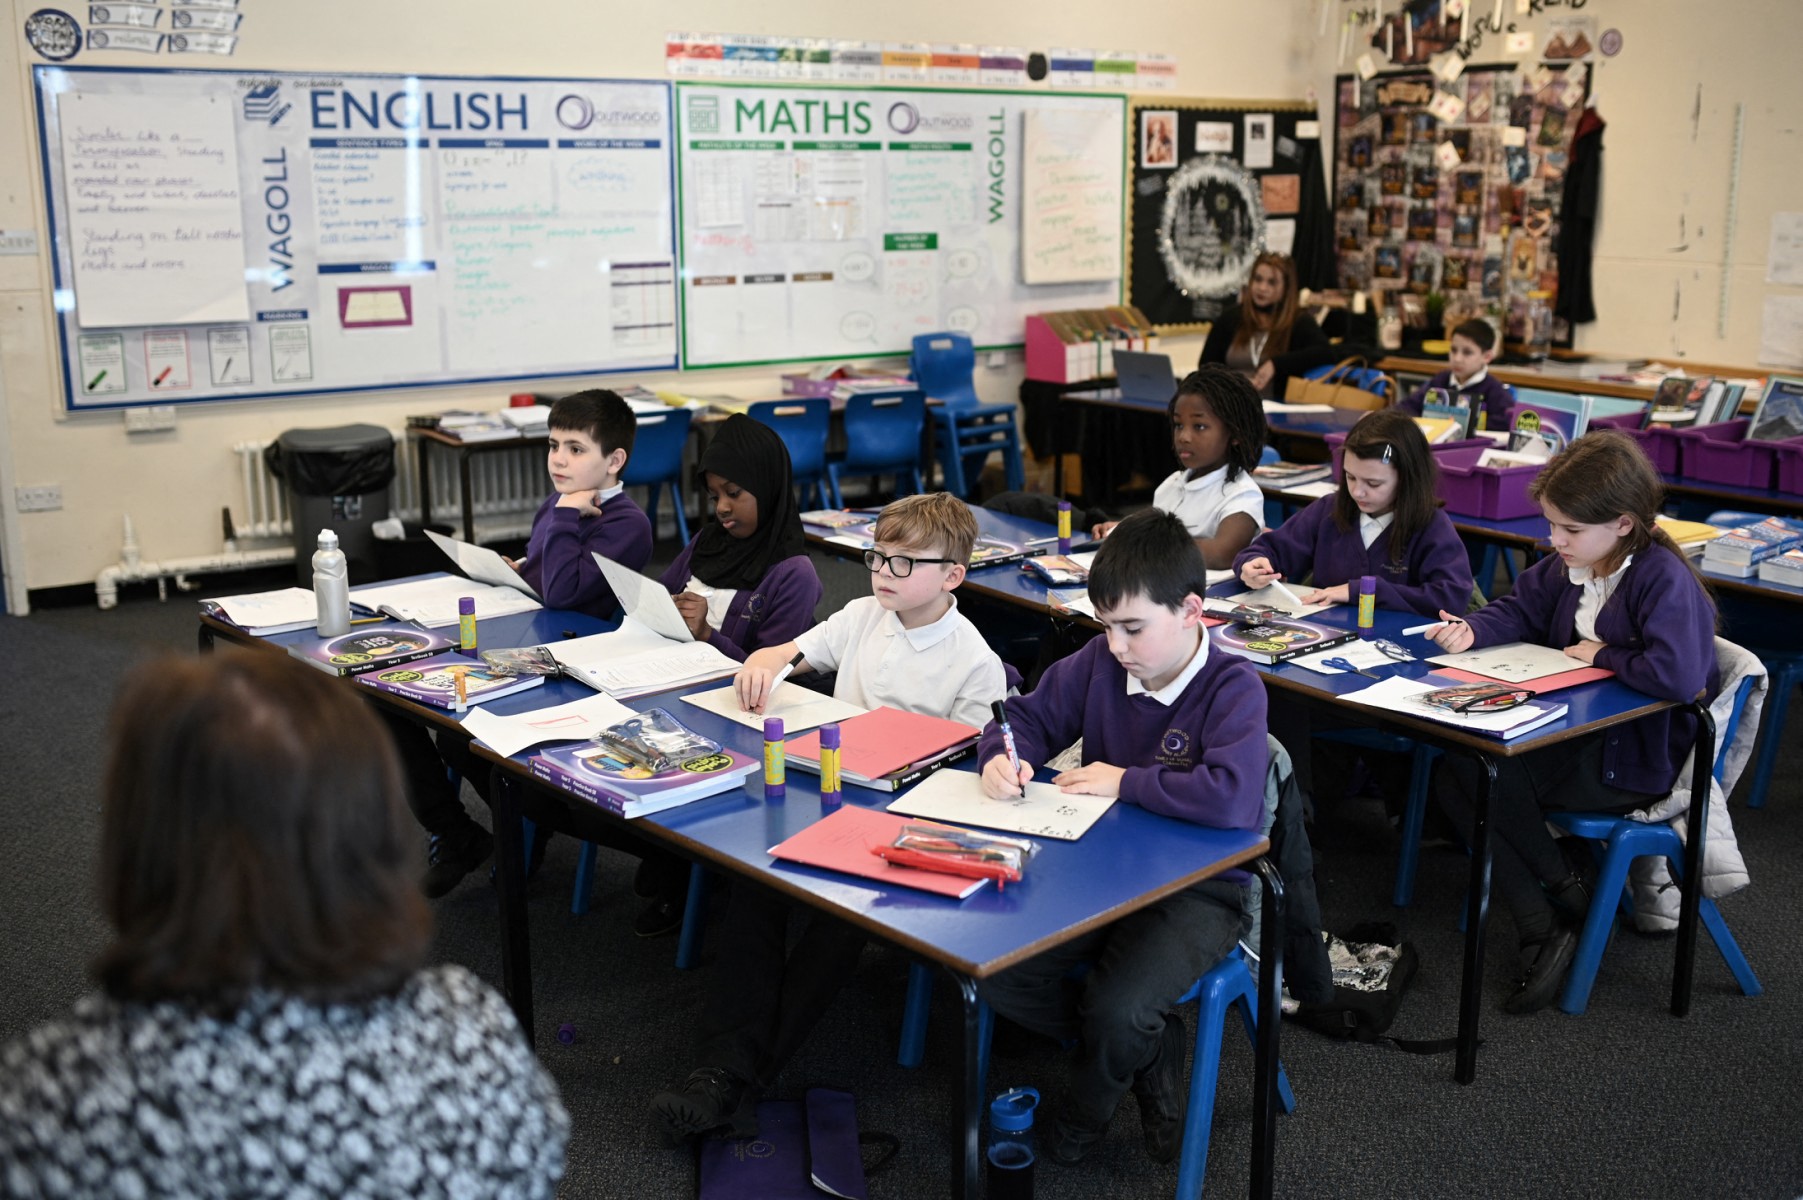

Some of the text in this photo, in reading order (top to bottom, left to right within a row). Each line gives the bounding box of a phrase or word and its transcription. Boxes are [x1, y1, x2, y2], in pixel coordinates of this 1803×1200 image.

[309, 90, 529, 131] ENGLISH
[735, 98, 872, 135] MATHS
[988, 107, 1005, 224] WAGOLL
[262, 146, 294, 293] WAGOLL
[902, 776, 912, 784] Power
